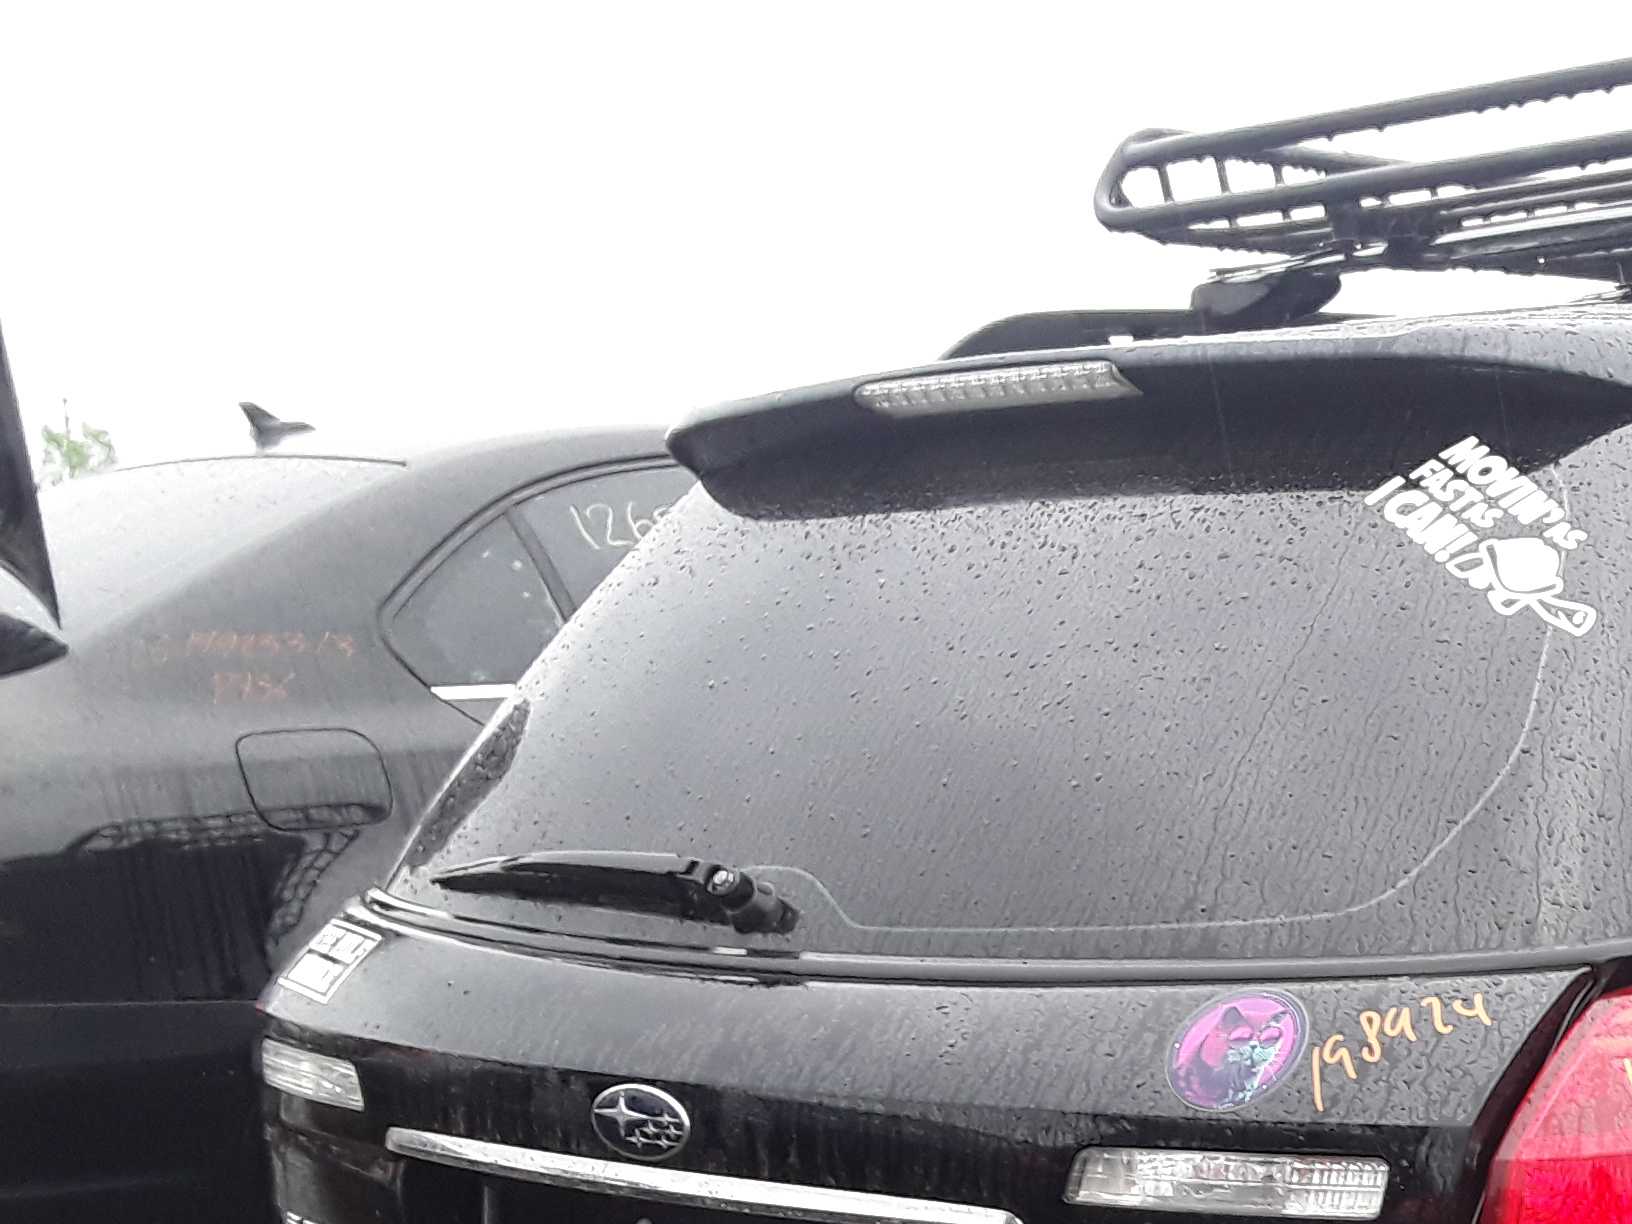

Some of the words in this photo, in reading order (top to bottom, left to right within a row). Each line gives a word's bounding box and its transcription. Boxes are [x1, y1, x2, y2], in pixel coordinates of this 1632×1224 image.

[1364, 475, 1406, 506] I
[1409, 459, 1485, 512] FAST
[1461, 502, 1504, 528] AS
[1383, 489, 1479, 562] CAN!
[1543, 522, 1588, 549] AS
[1311, 991, 1494, 1113] 198924
